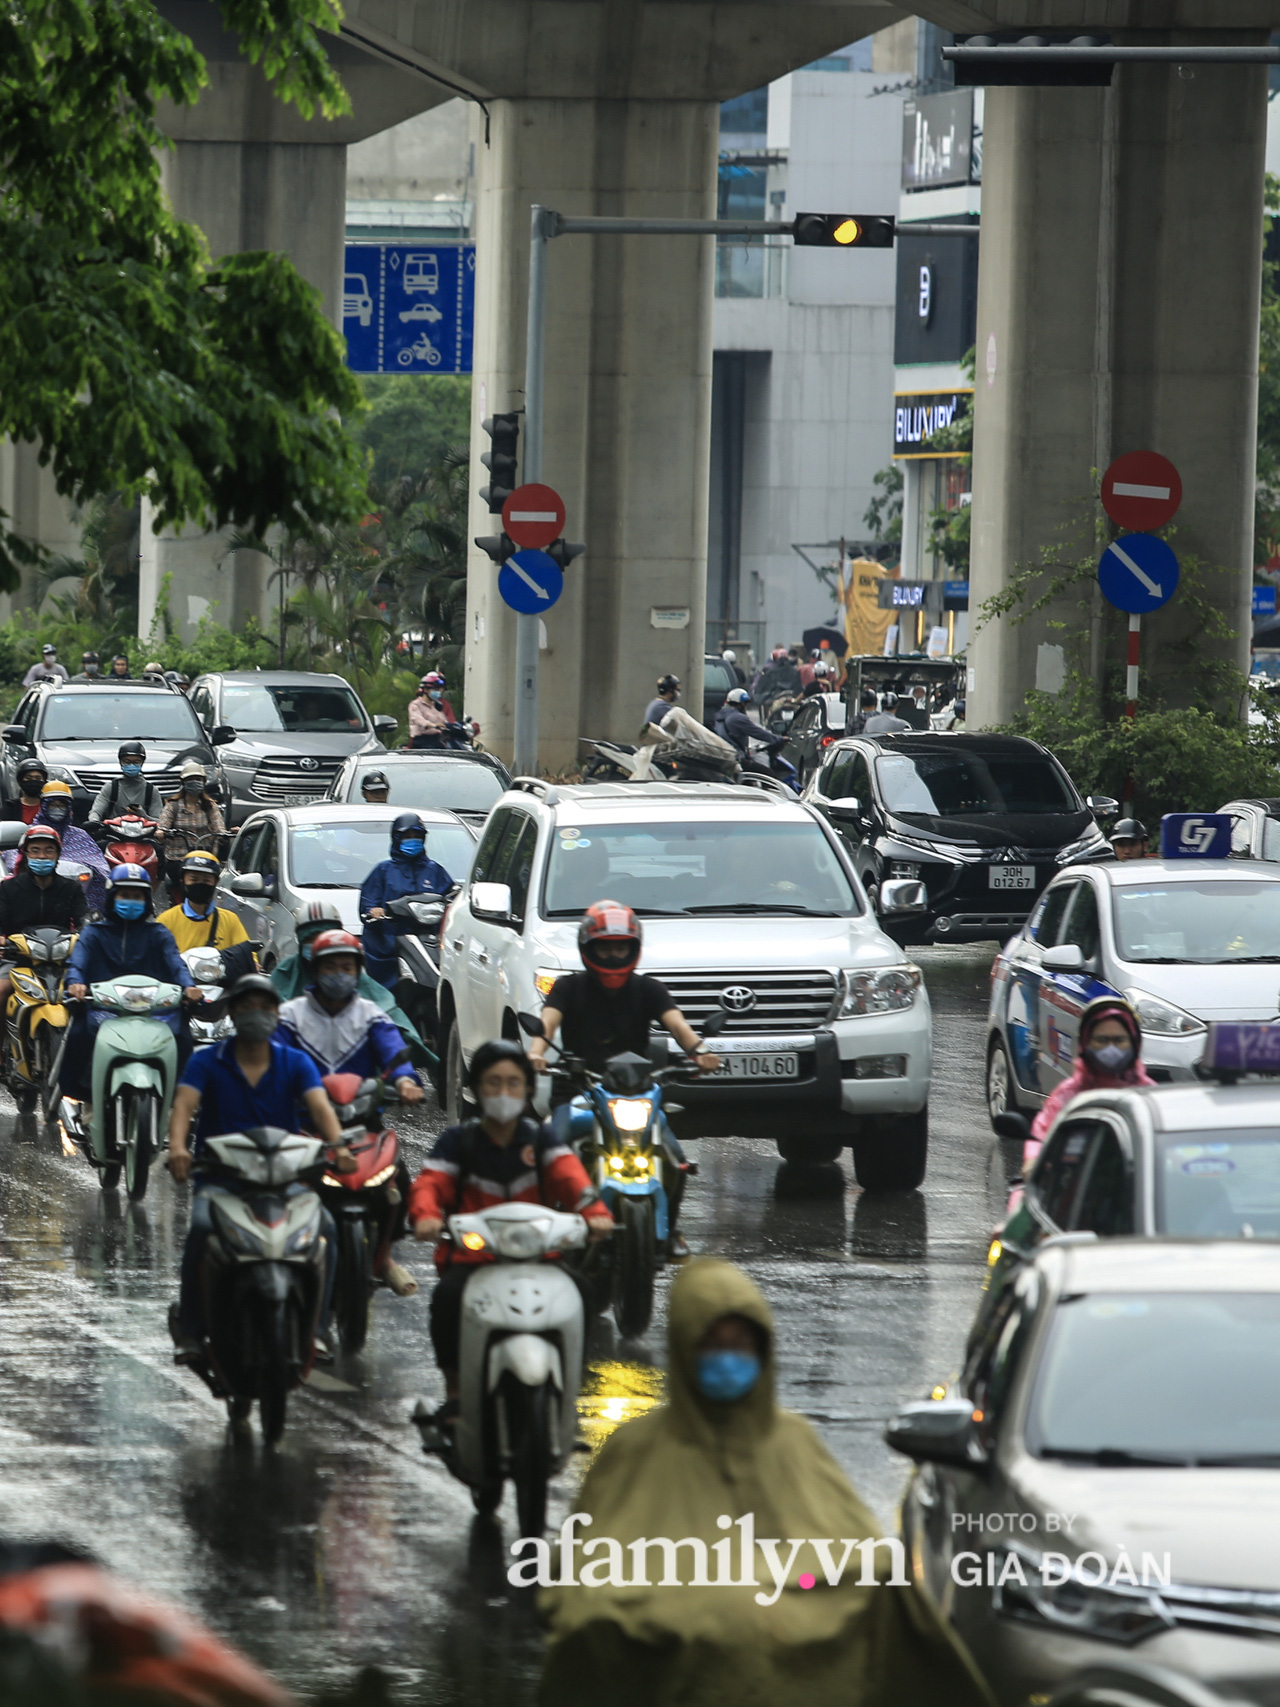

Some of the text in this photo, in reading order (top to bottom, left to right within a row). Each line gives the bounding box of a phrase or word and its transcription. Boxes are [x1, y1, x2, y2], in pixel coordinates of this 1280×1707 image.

[1180, 818, 1218, 853] G7
[1002, 867, 1023, 877] 30H
[994, 877, 1031, 888] 012.67
